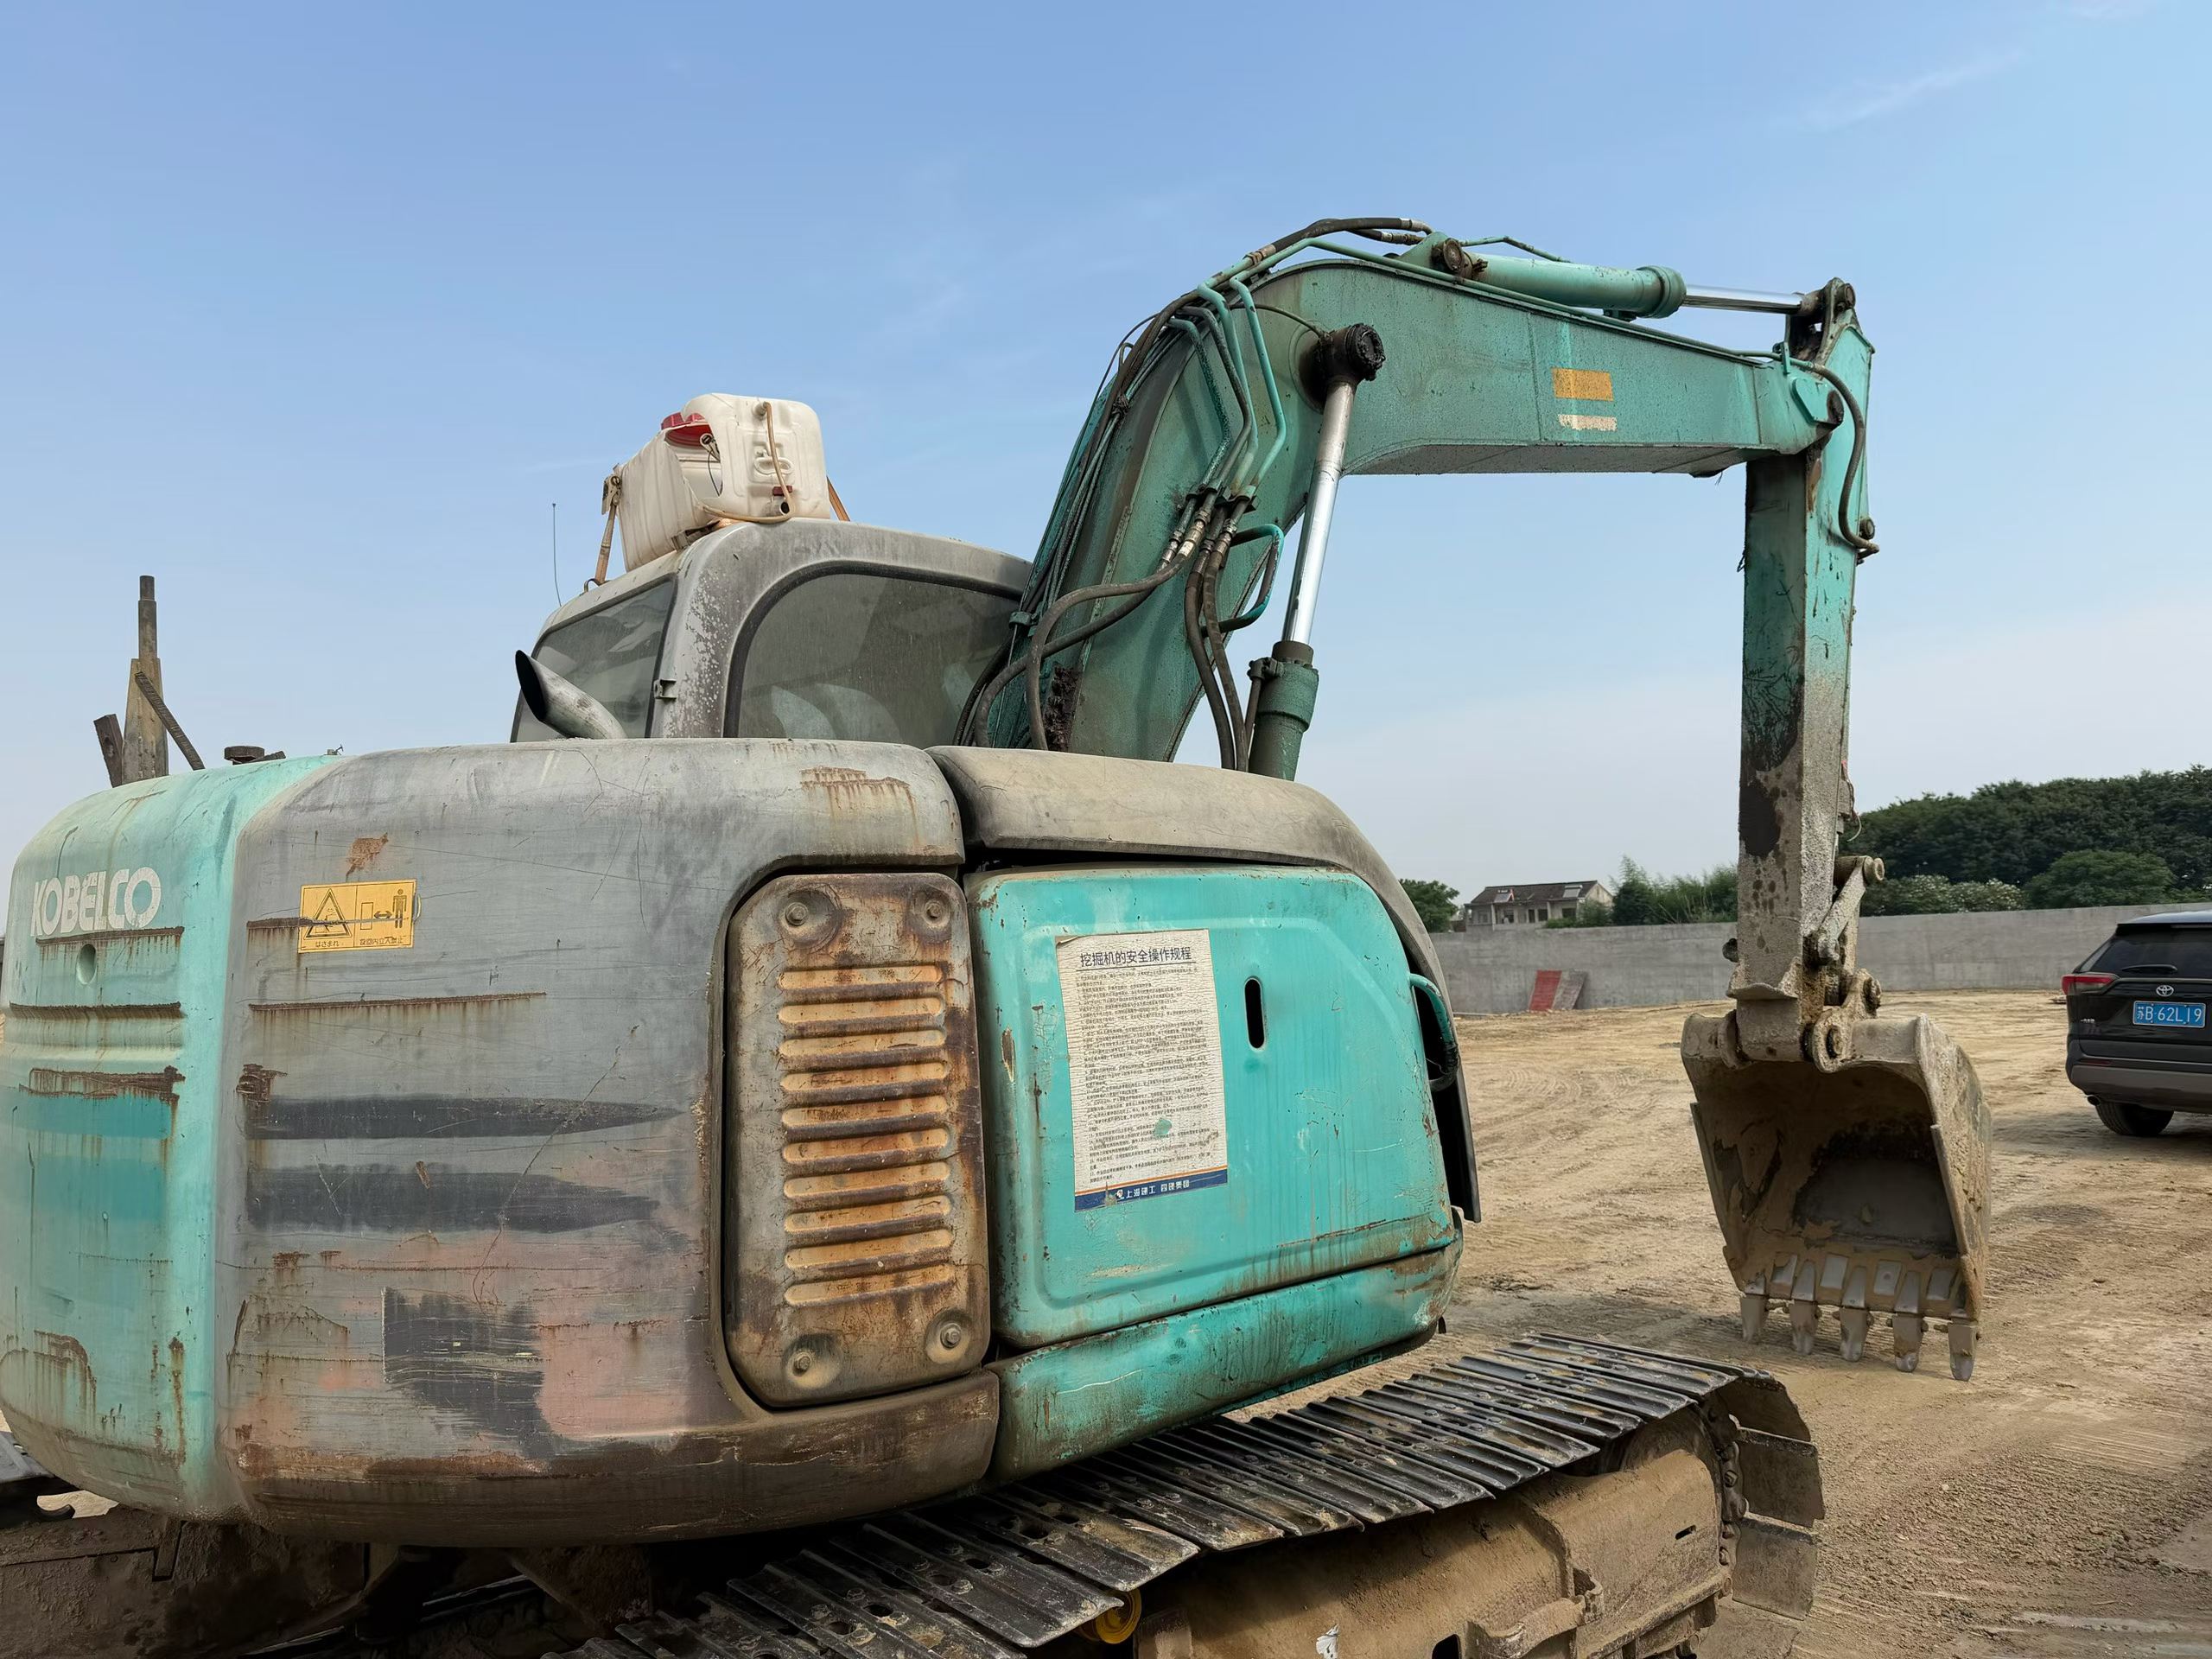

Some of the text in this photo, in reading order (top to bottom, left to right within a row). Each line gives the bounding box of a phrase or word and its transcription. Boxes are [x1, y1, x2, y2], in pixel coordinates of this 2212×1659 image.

[30, 867, 162, 937] KOBELCO
[1080, 946, 1192, 967] 挖掘机的安全操作规程
